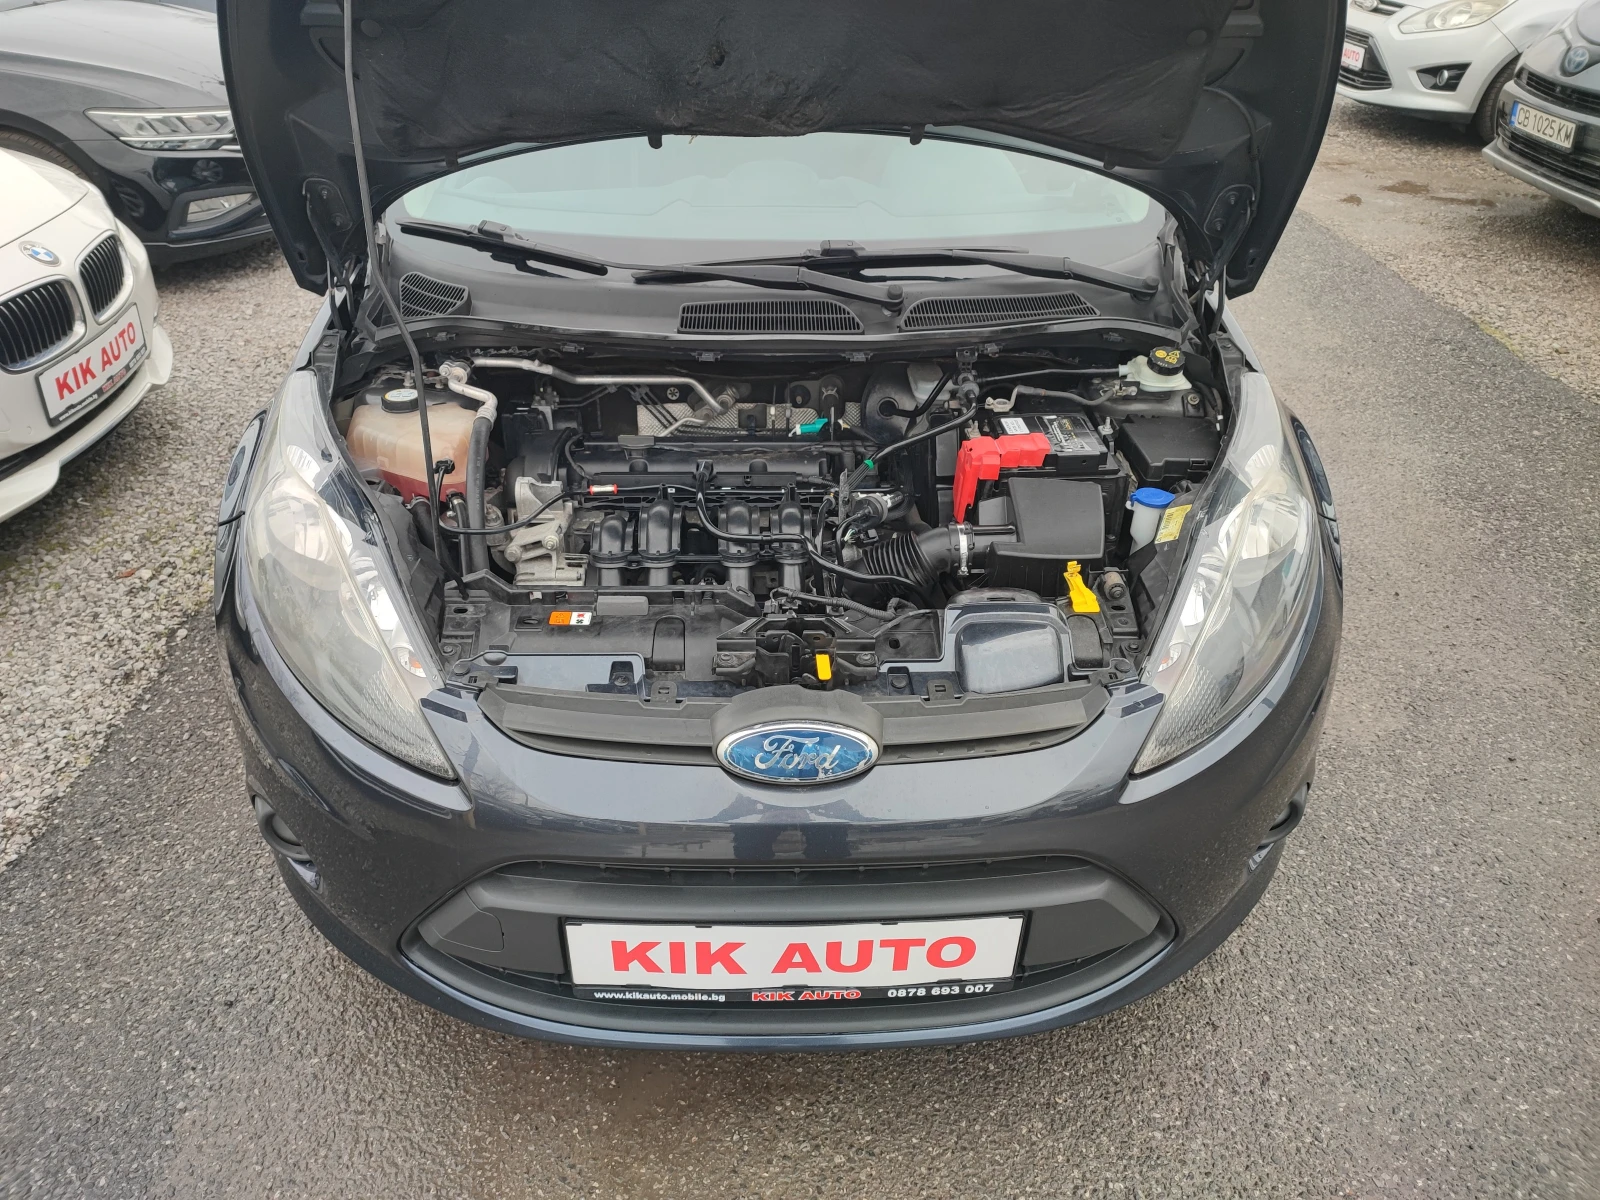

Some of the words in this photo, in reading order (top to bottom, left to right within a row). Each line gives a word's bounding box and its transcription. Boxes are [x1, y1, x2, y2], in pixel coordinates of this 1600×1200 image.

[1343, 47, 1360, 61] AUTO
[1517, 107, 1531, 127] CB
[1532, 113, 1556, 138] 1025
[1556, 122, 1574, 145] KM
[55, 356, 97, 401] KIK
[101, 321, 136, 373] AUTO
[754, 734, 841, 770] Ford
[611, 940, 747, 975] KIK
[771, 936, 977, 975] AUTO
[593, 991, 726, 1002] www.kikauto.mobile.bg
[751, 991, 795, 1002] KIK
[797, 989, 862, 1001] AUTO
[887, 987, 927, 998] 0878
[931, 985, 960, 996] 693
[965, 984, 994, 994] 007
